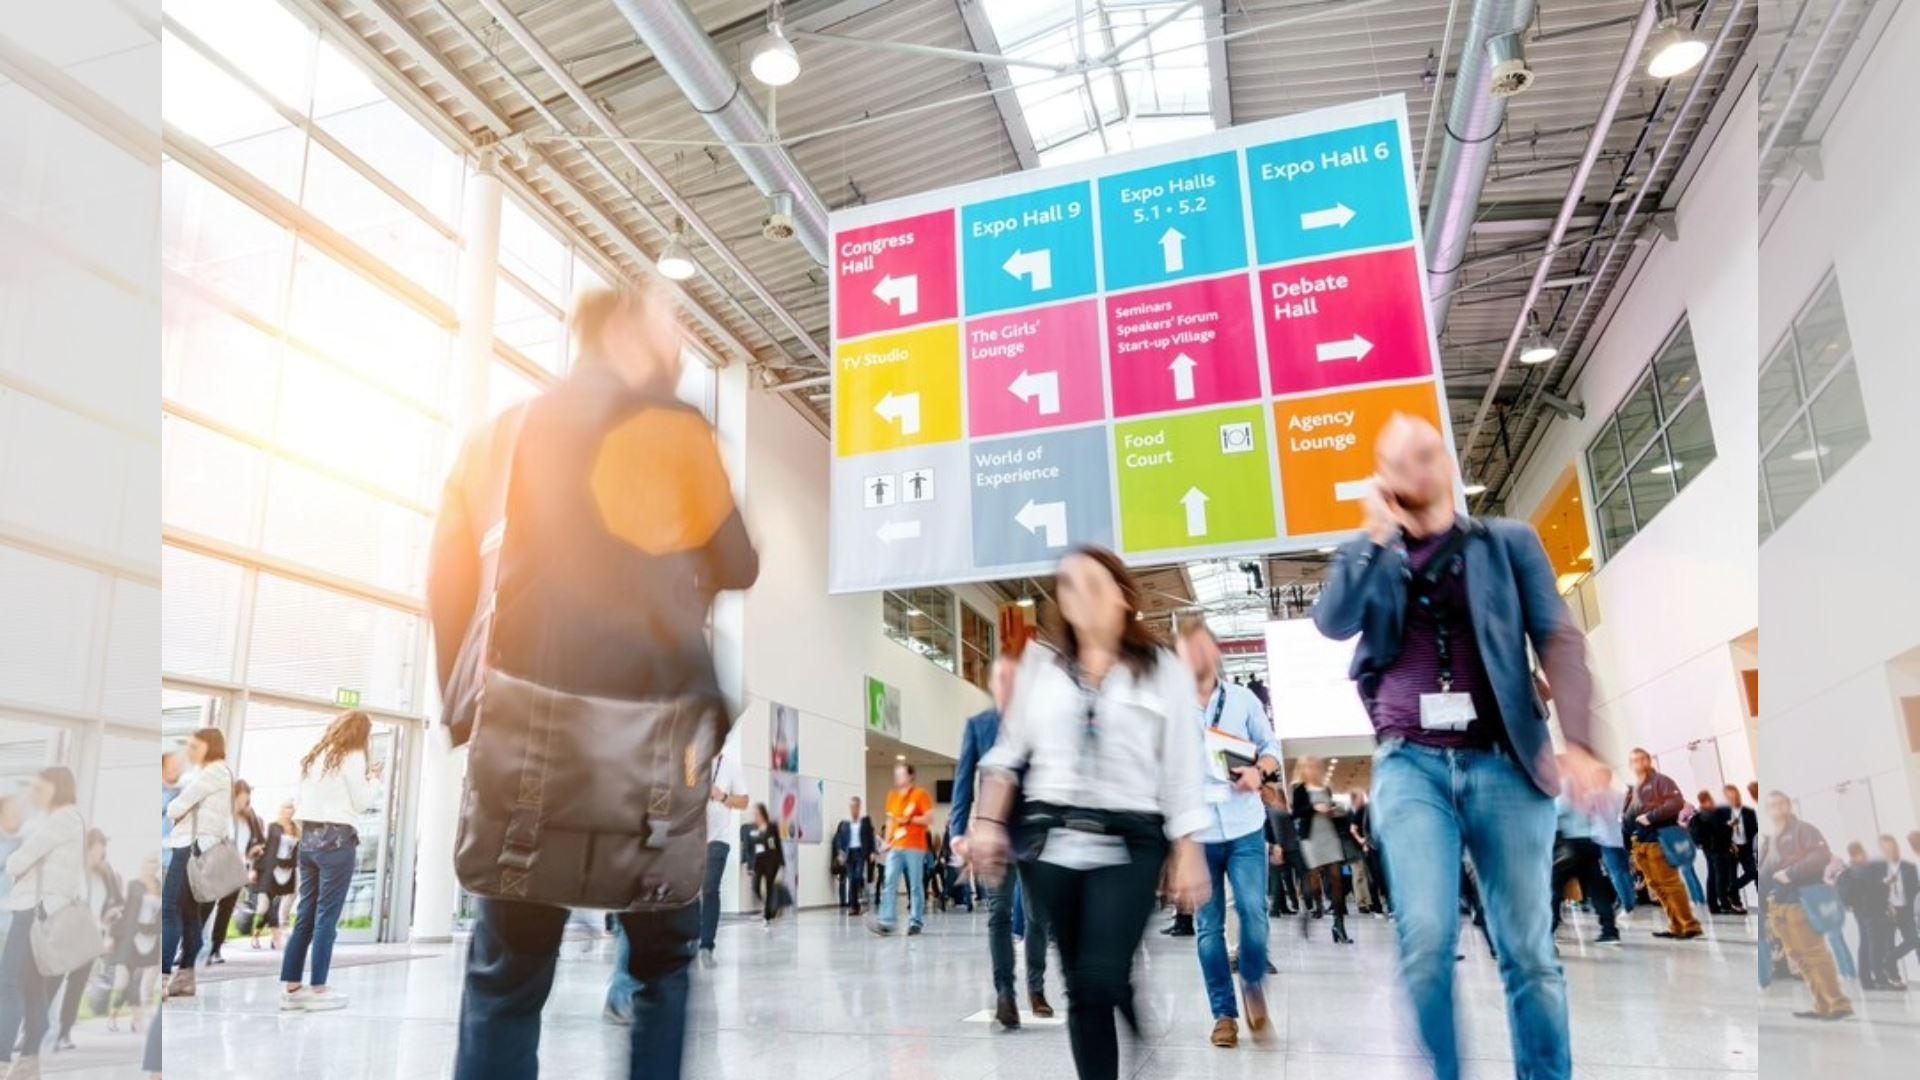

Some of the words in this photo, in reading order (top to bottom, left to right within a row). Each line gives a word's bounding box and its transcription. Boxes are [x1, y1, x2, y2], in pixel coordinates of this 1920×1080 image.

[1261, 158, 1315, 181] Expo
[1321, 145, 1368, 170] Hall
[1374, 141, 1390, 161] 6
[1120, 184, 1164, 205] Expo
[1169, 172, 1217, 193] Halls
[972, 216, 1018, 238] Expo
[1023, 205, 1063, 227] Hall
[1068, 201, 1082, 218] 9
[1133, 206, 1161, 223] 5.1
[1178, 197, 1207, 215] 5.2
[841, 232, 915, 257] Congress
[842, 255, 875, 276] Hall
[1271, 272, 1349, 299] Debate
[1115, 300, 1173, 319] Seminars
[1177, 310, 1219, 326] Forum
[1274, 298, 1319, 320] Hall
[971, 328, 997, 344] The
[1117, 334, 1170, 354] Start-up
[1173, 328, 1216, 347] Village
[842, 356, 861, 371] TV
[863, 348, 910, 367] Studio
[972, 340, 1025, 360] Lounge
[1288, 409, 1356, 434] Agency
[1124, 428, 1165, 450] Food
[1290, 431, 1357, 453] Lounge
[975, 447, 1023, 468] World
[1027, 446, 1043, 461] of
[1126, 449, 1174, 468] Court
[976, 465, 1060, 489] Experience
